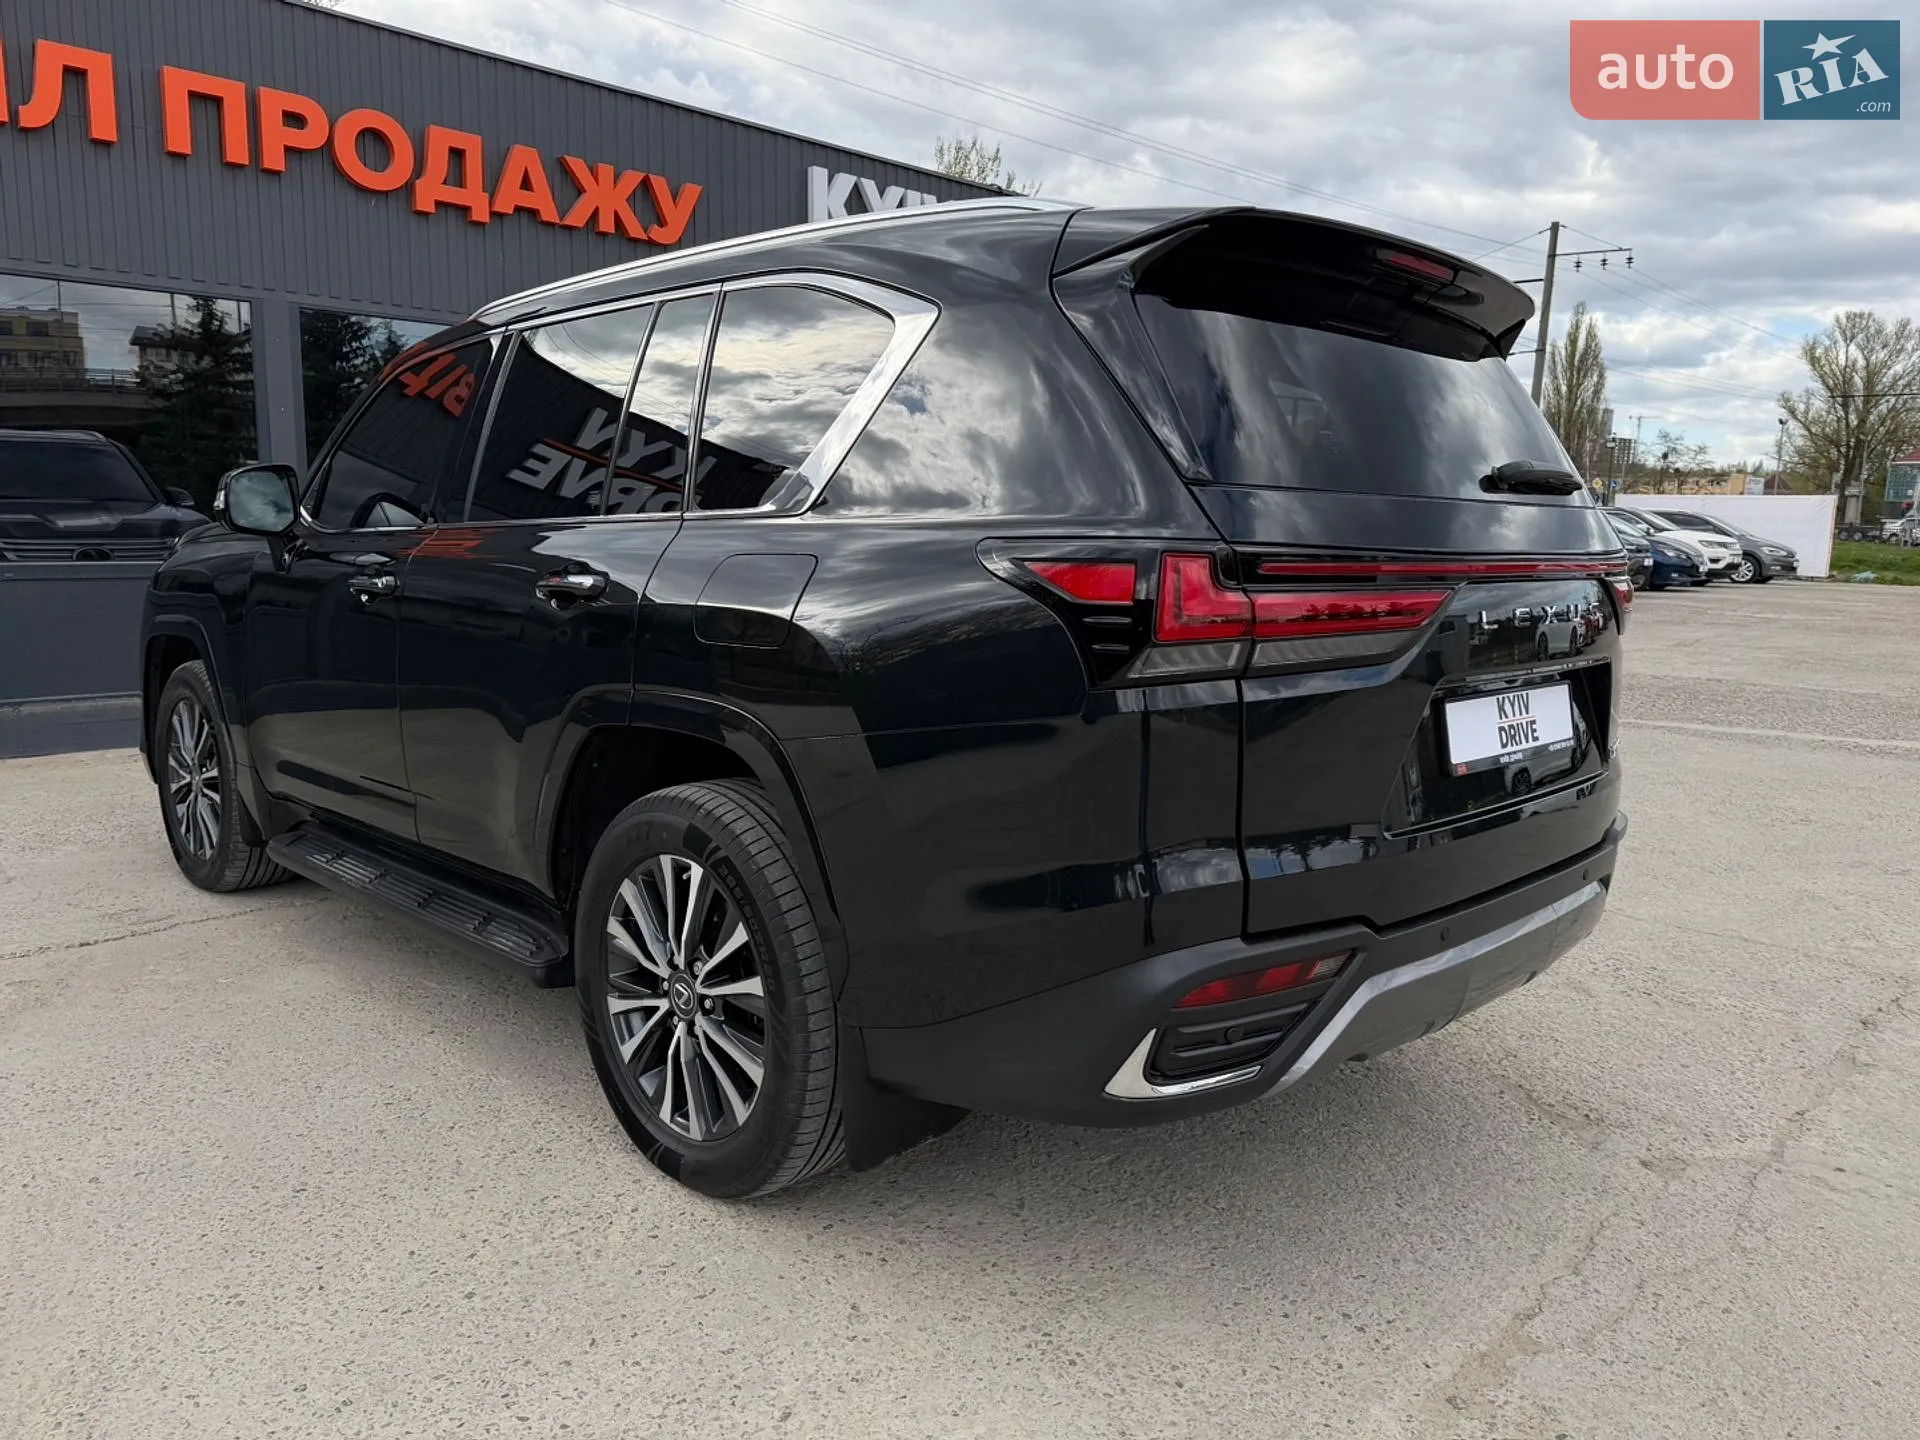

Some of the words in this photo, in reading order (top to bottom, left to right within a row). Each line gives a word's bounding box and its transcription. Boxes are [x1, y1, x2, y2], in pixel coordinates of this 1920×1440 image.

[160, 65, 703, 245] ПРОДАЖУ
[1496, 692, 1530, 720] KYIV
[1497, 719, 1540, 749] DRIVE
